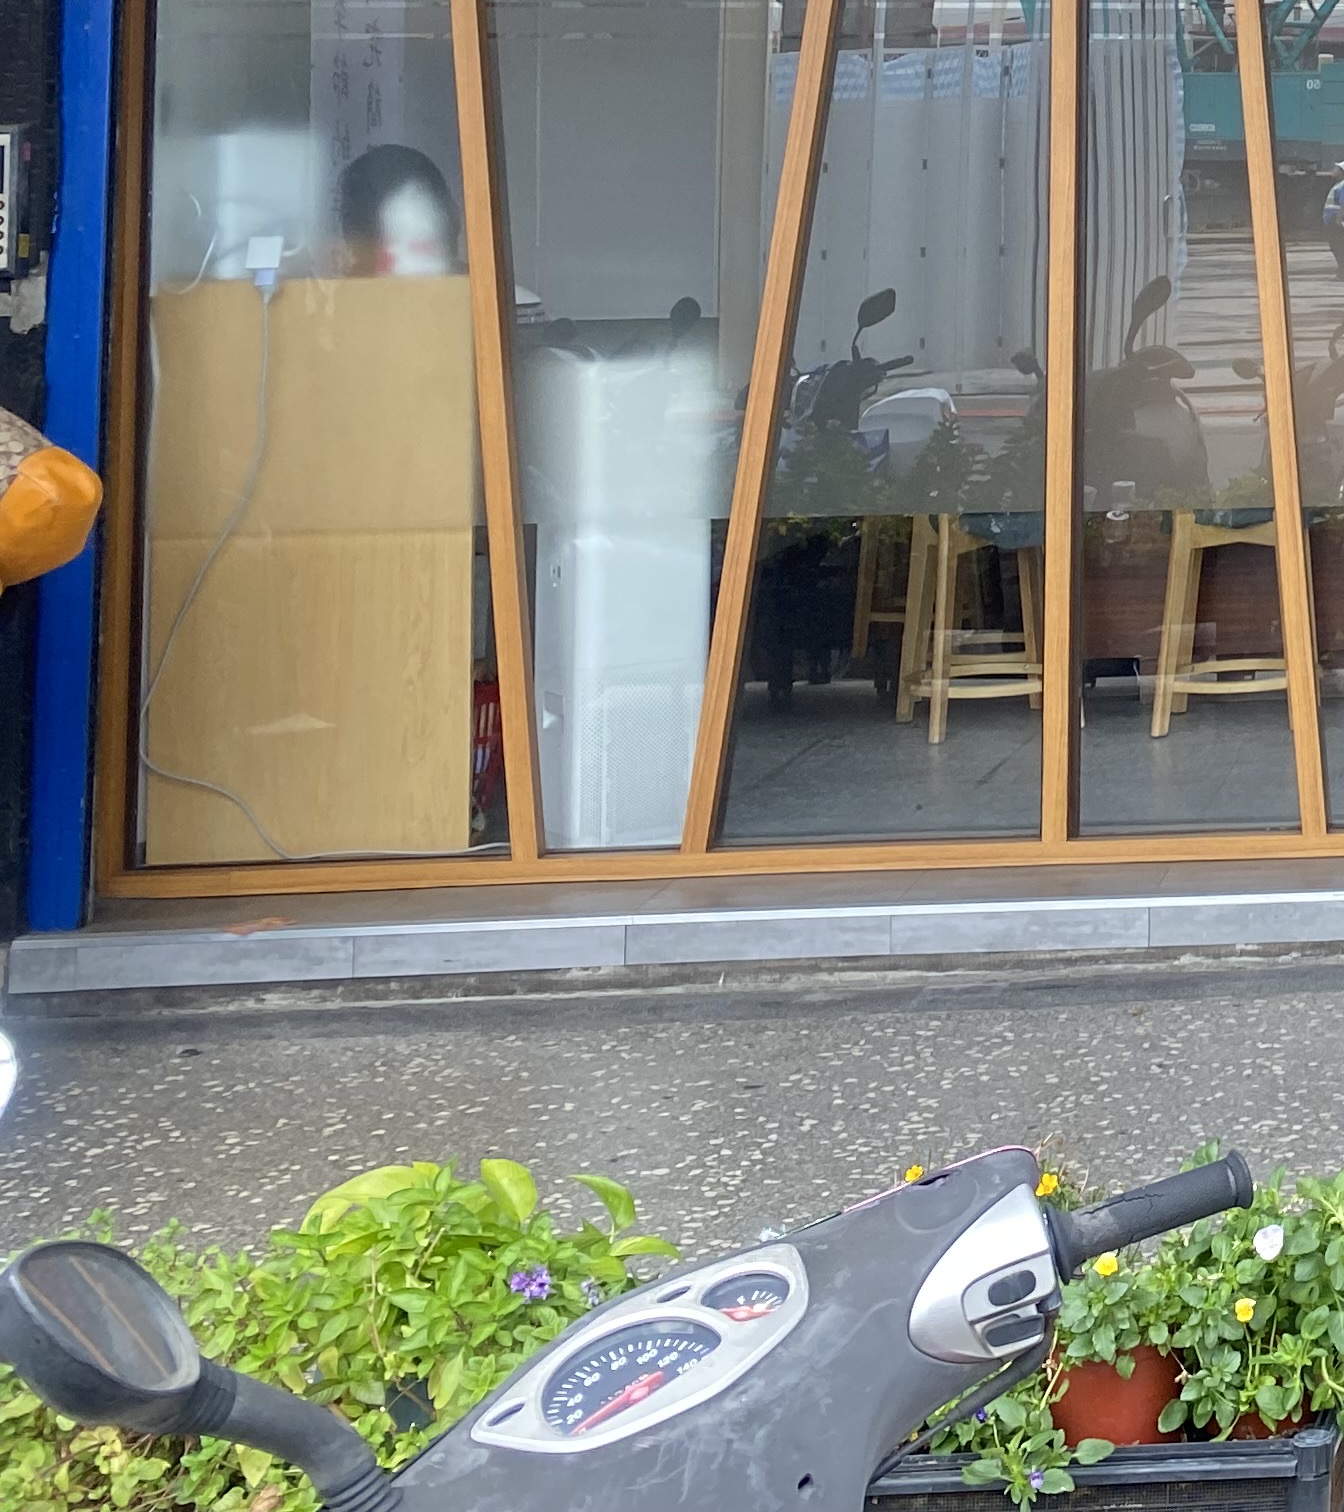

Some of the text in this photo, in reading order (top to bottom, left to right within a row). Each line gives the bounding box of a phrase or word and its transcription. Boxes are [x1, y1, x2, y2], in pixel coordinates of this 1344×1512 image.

[676, 1358, 698, 1375] 140
[567, 1393, 583, 1407] 40
[566, 1409, 583, 1425] 20
